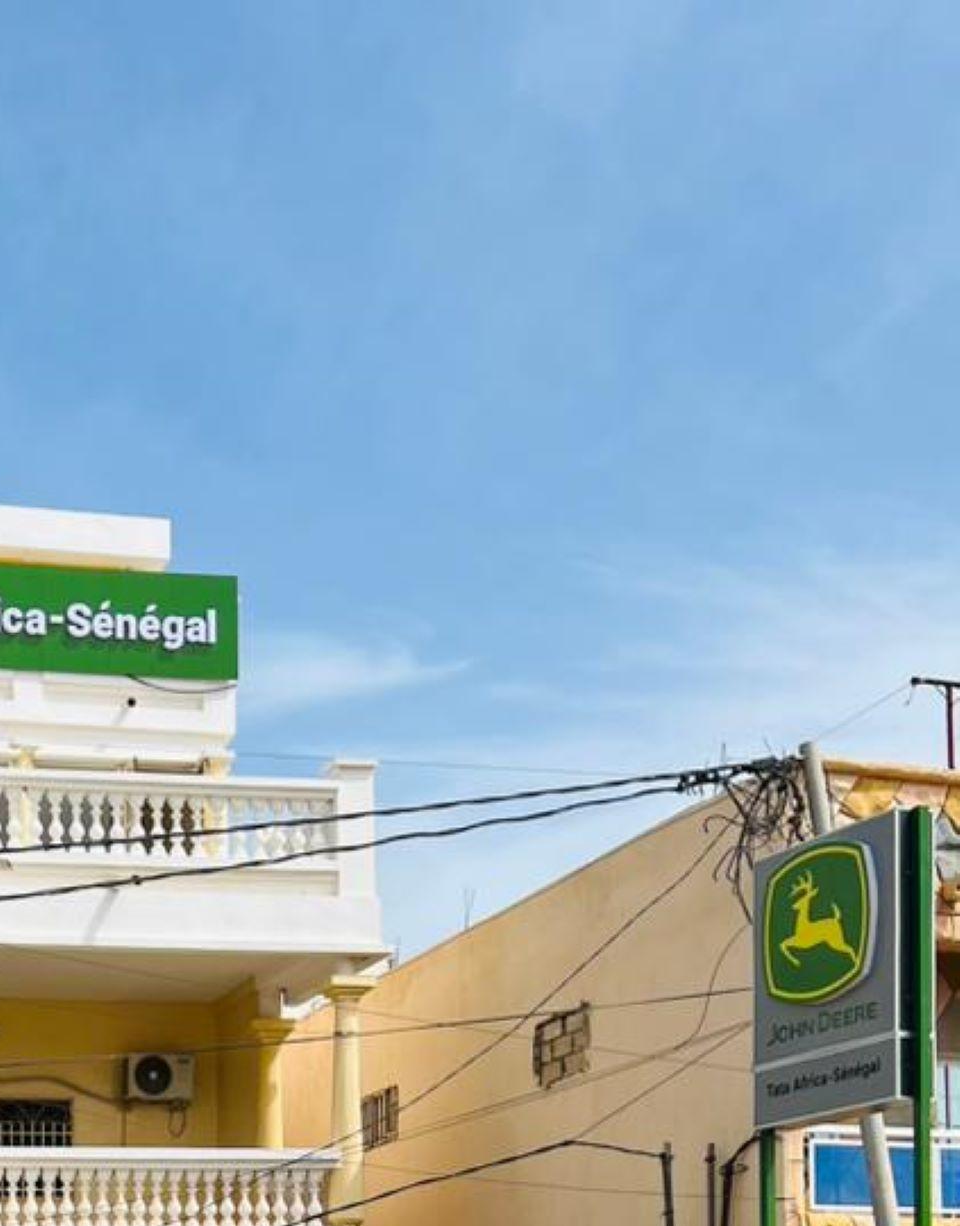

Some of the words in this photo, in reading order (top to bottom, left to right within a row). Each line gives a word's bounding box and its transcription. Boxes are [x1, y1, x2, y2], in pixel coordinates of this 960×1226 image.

[767, 1019, 816, 1047] JOHN
[817, 1001, 879, 1033] DEERE
[766, 1081, 790, 1098] Tata
